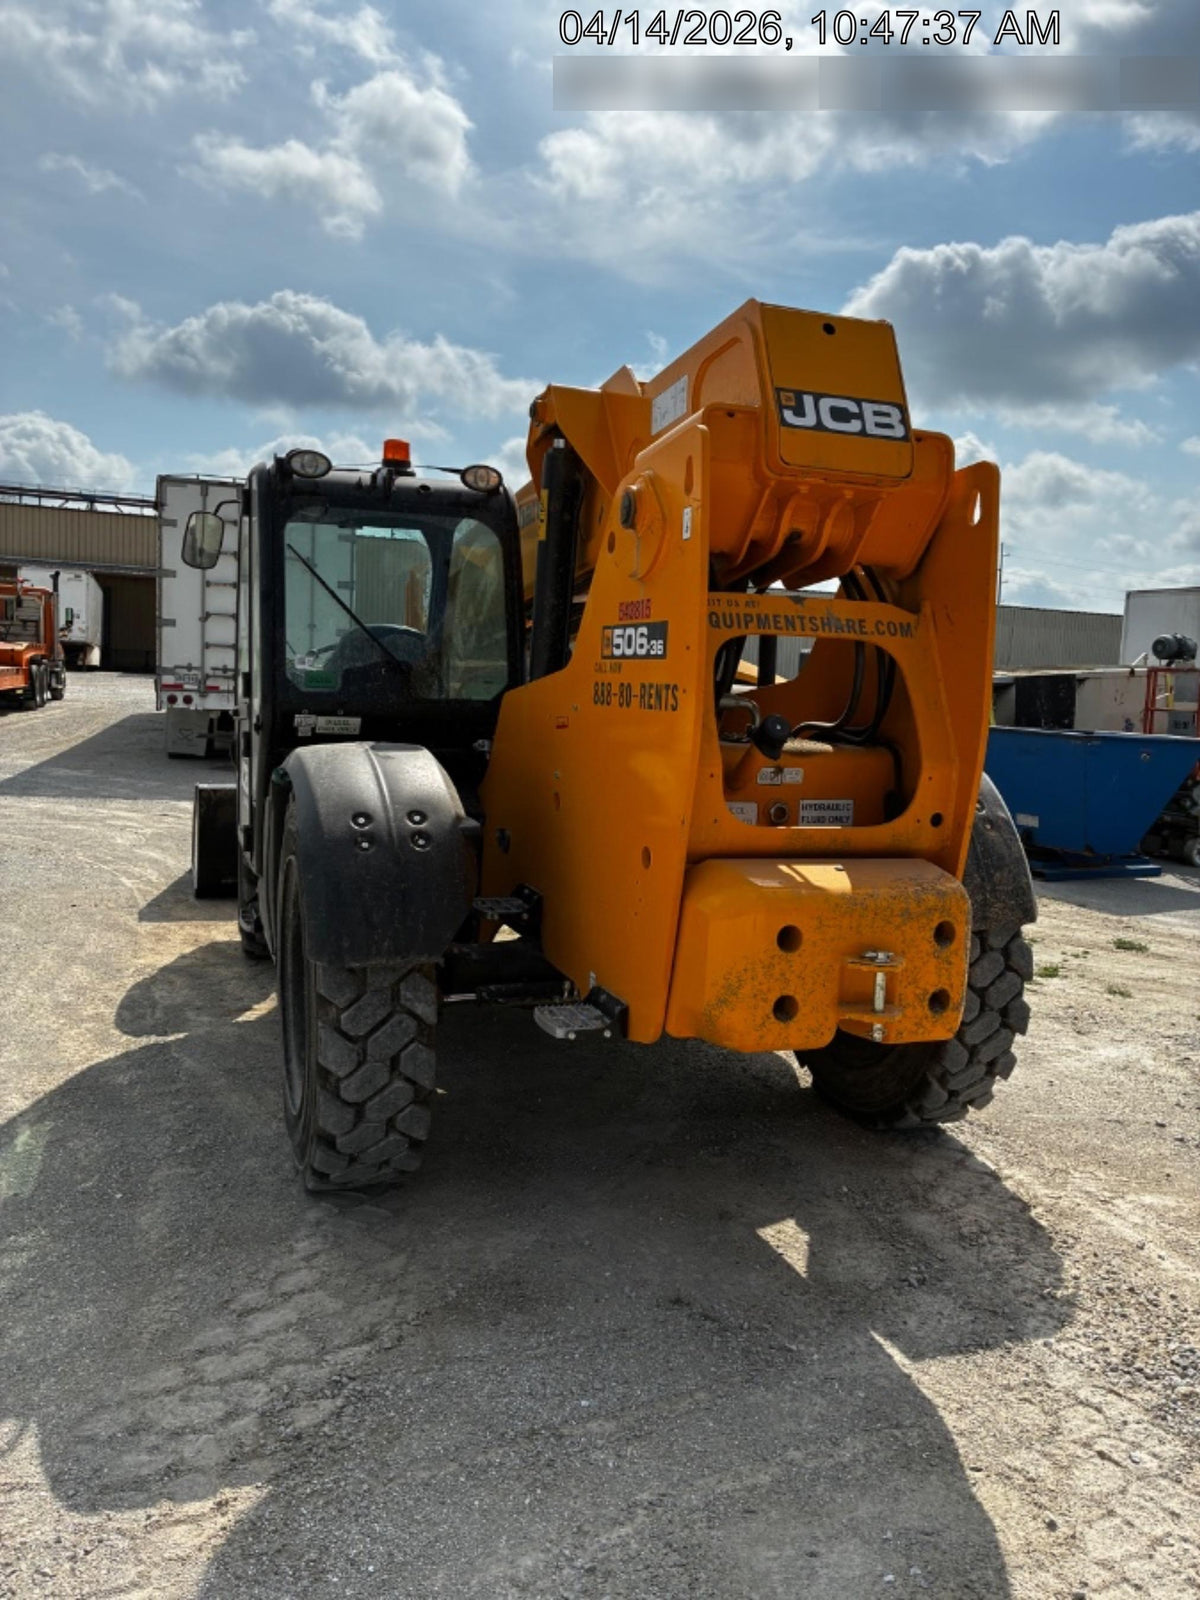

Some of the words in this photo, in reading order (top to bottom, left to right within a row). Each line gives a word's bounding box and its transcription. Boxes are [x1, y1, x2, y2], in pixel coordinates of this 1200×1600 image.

[782, 394, 906, 438] JCB
[708, 611, 913, 638] QUIPMENTSHARE.COM
[593, 681, 679, 712] 888-80-RENTS
[801, 802, 852, 812] HYDRAULIC
[801, 815, 827, 825] FLUID
[828, 815, 851, 825] ONLY
